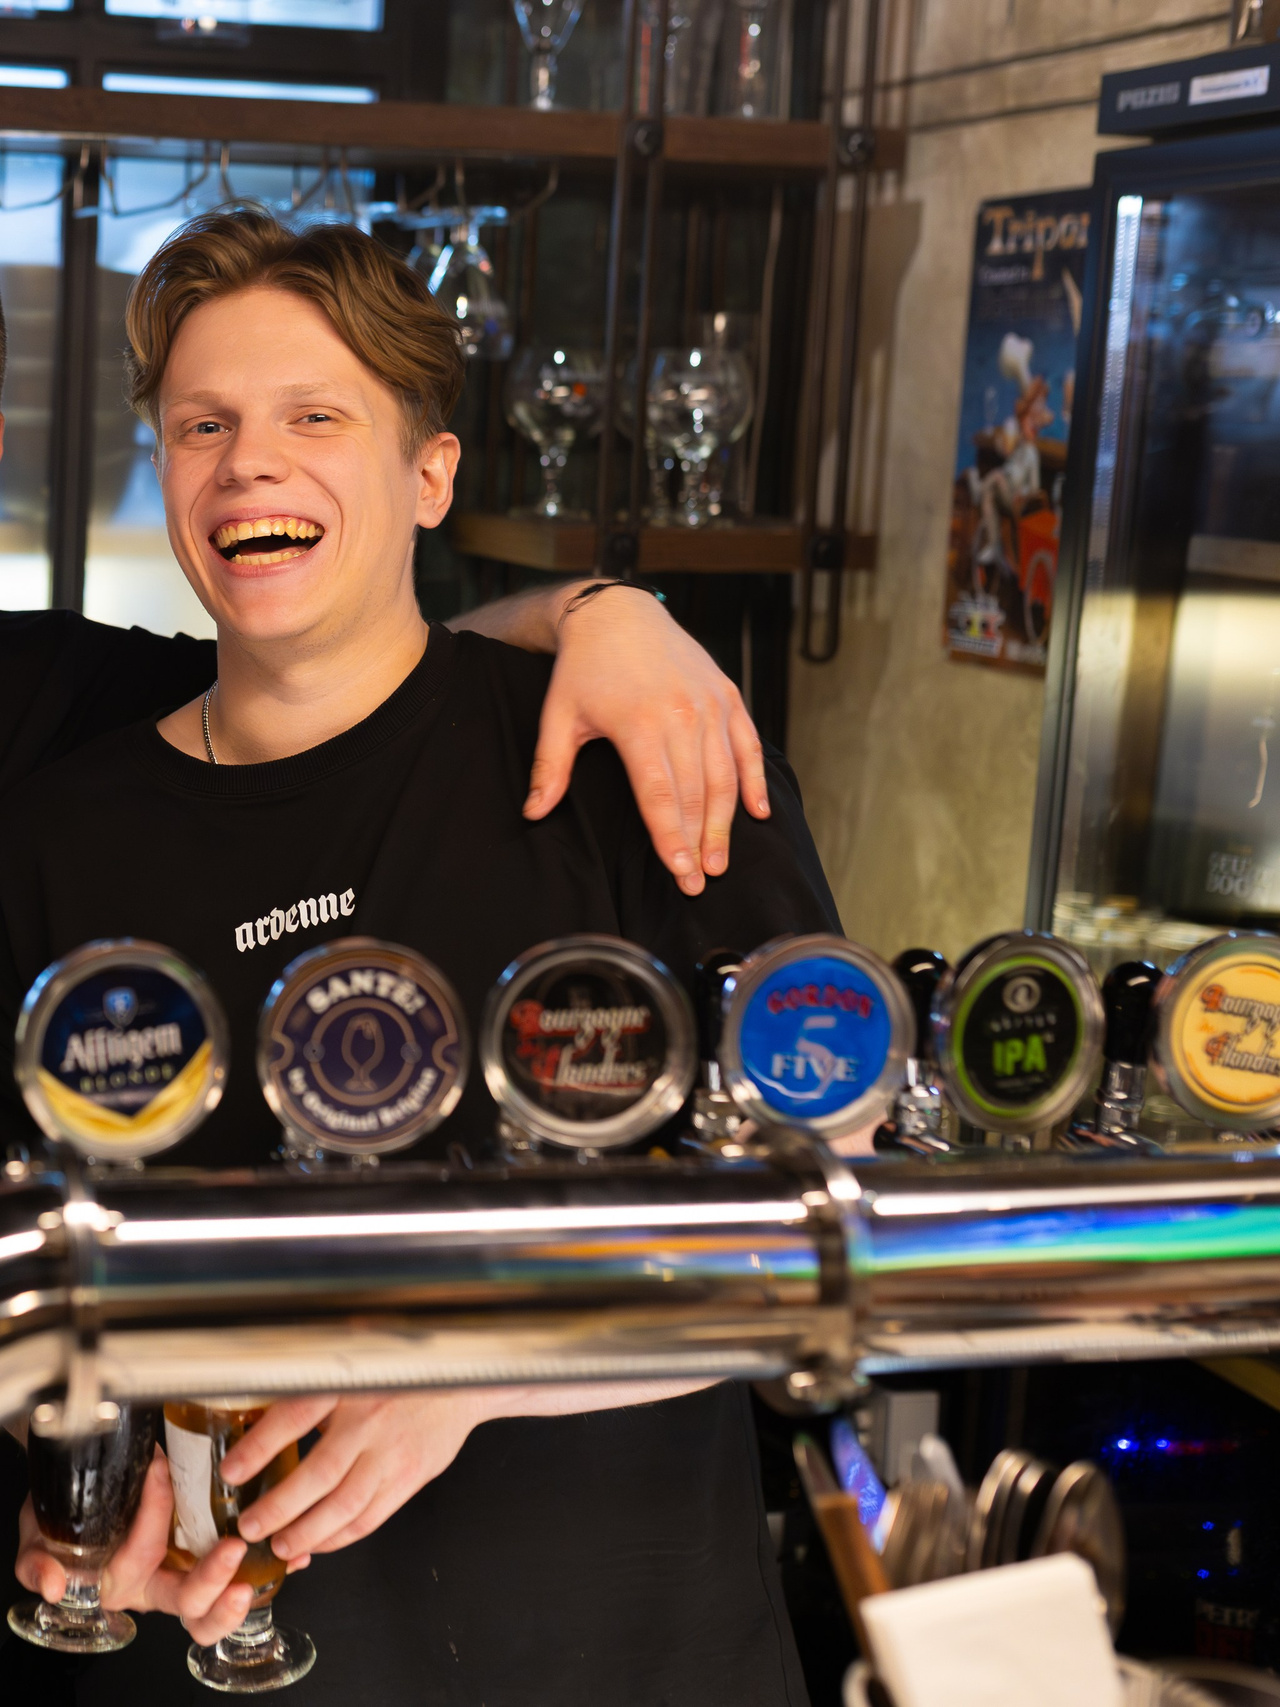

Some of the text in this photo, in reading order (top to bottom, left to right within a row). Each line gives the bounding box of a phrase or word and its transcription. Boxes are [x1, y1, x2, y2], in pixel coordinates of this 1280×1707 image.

[235, 887, 356, 953] ardenne
[59, 1022, 183, 1075] Affligem
[771, 1052, 858, 1083] FIVE
[992, 1034, 1047, 1077] IPA
